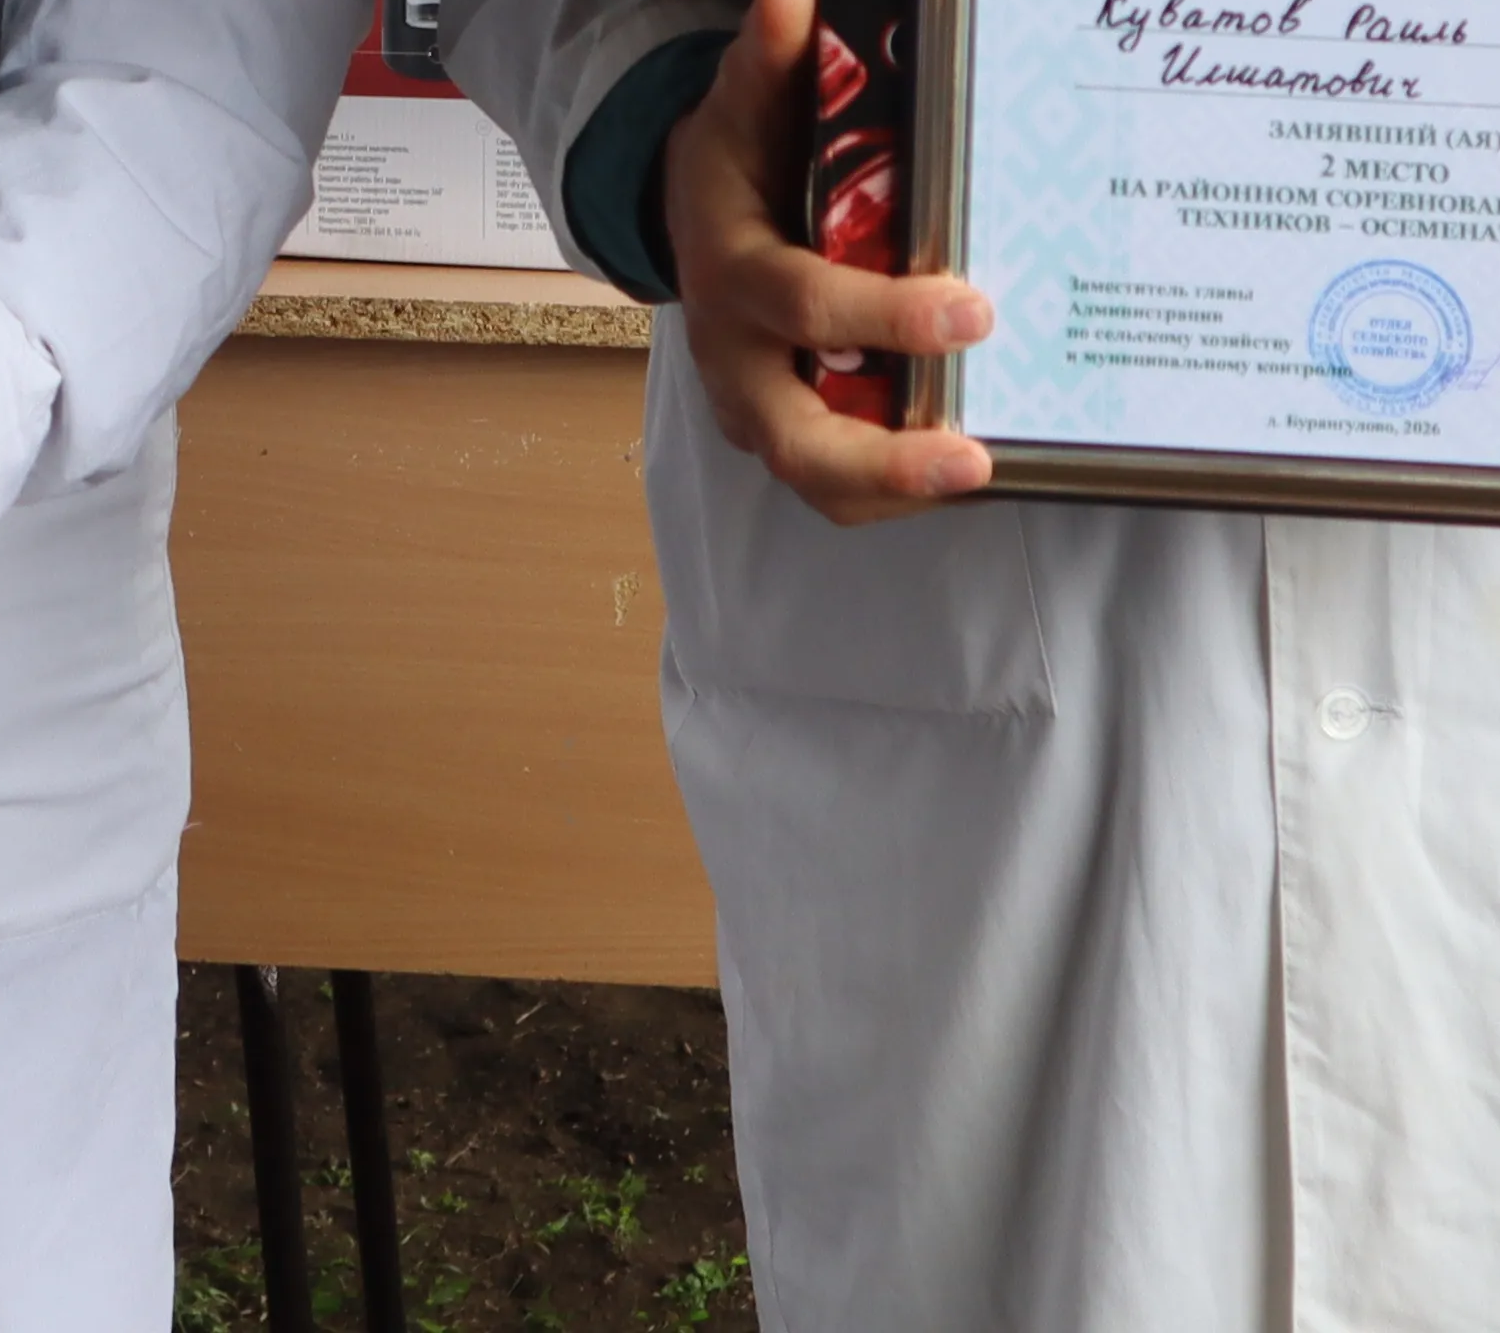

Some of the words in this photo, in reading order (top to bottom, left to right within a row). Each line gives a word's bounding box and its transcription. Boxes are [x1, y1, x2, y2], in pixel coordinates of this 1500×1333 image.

[1268, 120, 1437, 147] ЗАНЯВШИЙ
[1321, 153, 1335, 178] 2
[1345, 158, 1450, 184] МЕСТО
[1109, 177, 1148, 198] НА
[1155, 180, 1318, 207] РАЙОННОМ
[1176, 207, 1331, 233] ТЕХНИКОВ
